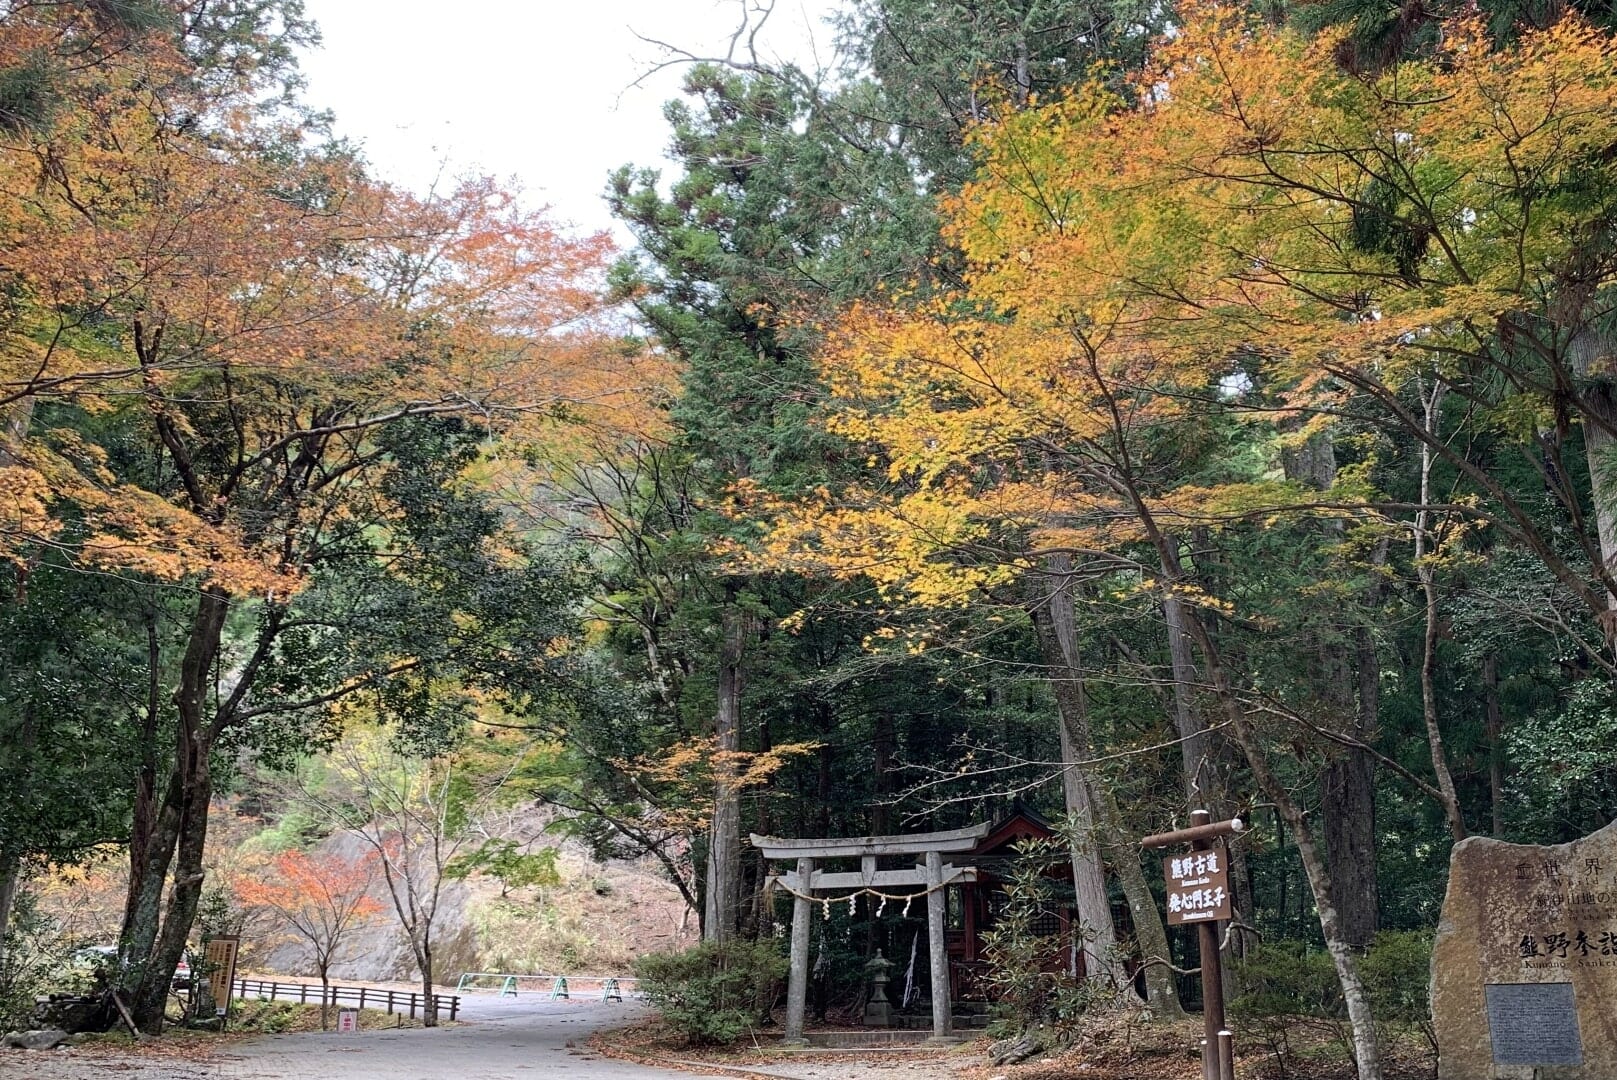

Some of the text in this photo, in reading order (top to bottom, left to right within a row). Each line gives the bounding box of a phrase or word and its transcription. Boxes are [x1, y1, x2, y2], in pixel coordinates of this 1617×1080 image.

[1171, 852, 1220, 879] 熊野古道
[1168, 886, 1226, 913] 発心門王子
